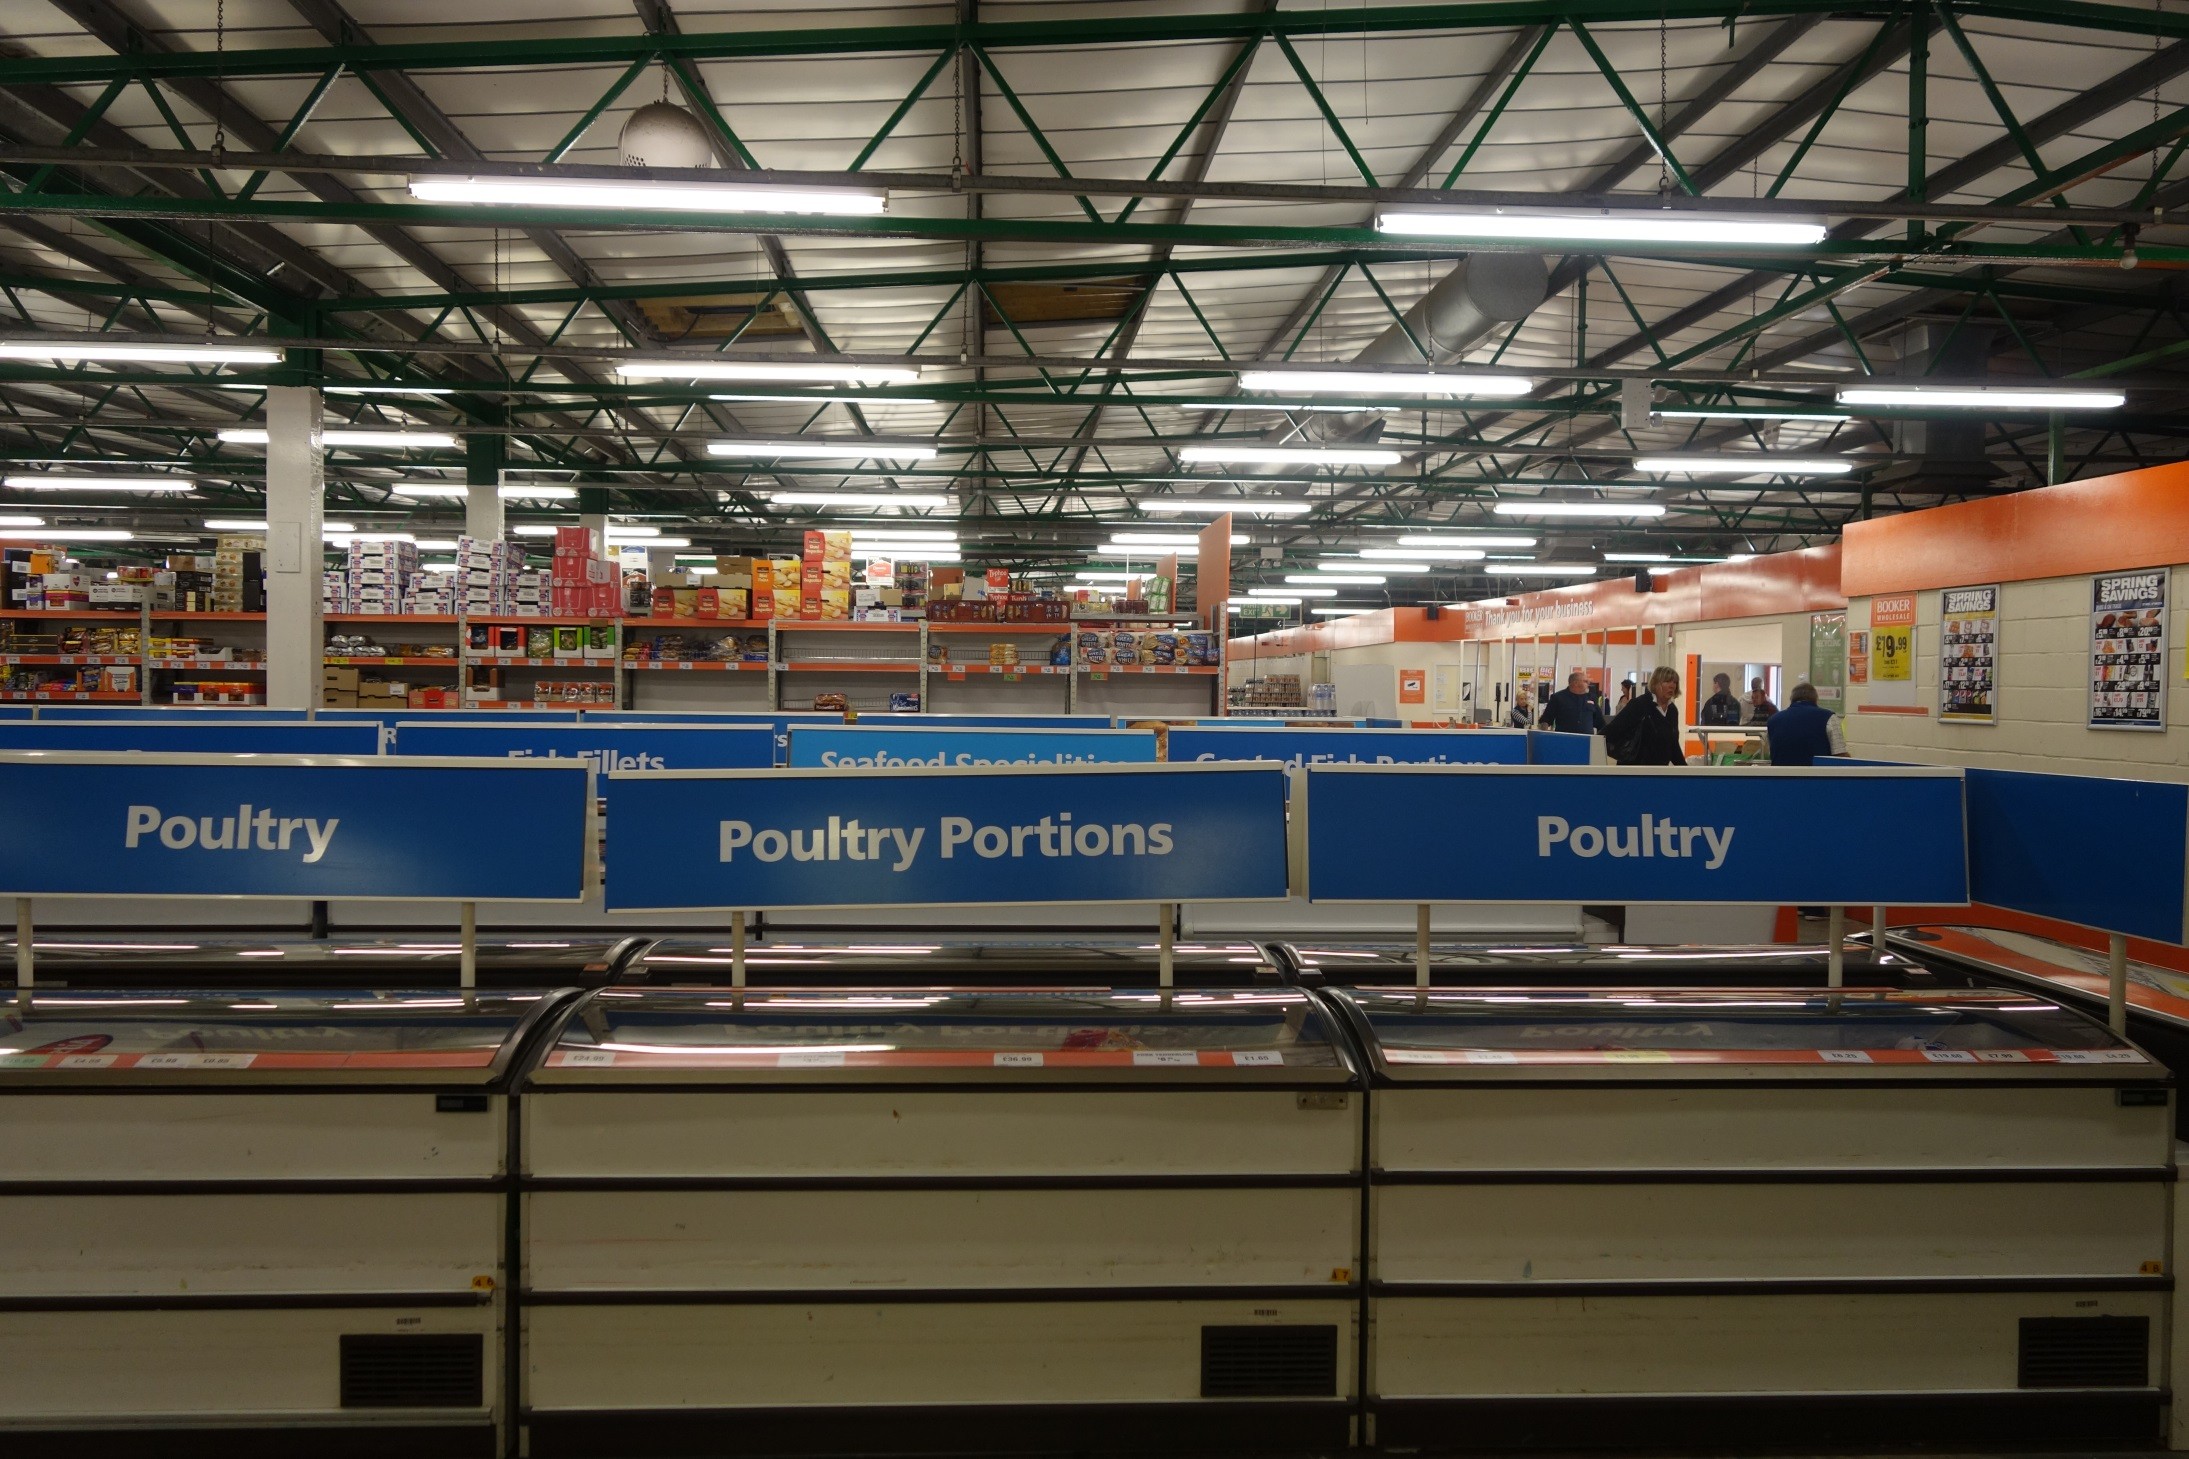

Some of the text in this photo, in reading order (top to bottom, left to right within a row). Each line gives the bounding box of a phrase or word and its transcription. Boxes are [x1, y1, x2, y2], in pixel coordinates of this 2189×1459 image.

[989, 569, 1007, 578] Typhoo
[2101, 574, 2158, 591] SPRING
[1949, 590, 1991, 603] SPRING
[2101, 586, 2158, 603] SAVINGS
[1485, 598, 1594, 628] Thank you for your business
[1876, 599, 1910, 613] BOOKER
[1948, 599, 1991, 613] SAVINGS
[1876, 613, 1910, 621] WHOLESALE
[1876, 635, 1907, 658] £19.99
[125, 804, 340, 863] Poultry
[719, 811, 1174, 872] Poultry Portions
[1537, 813, 1736, 870] Poultry
